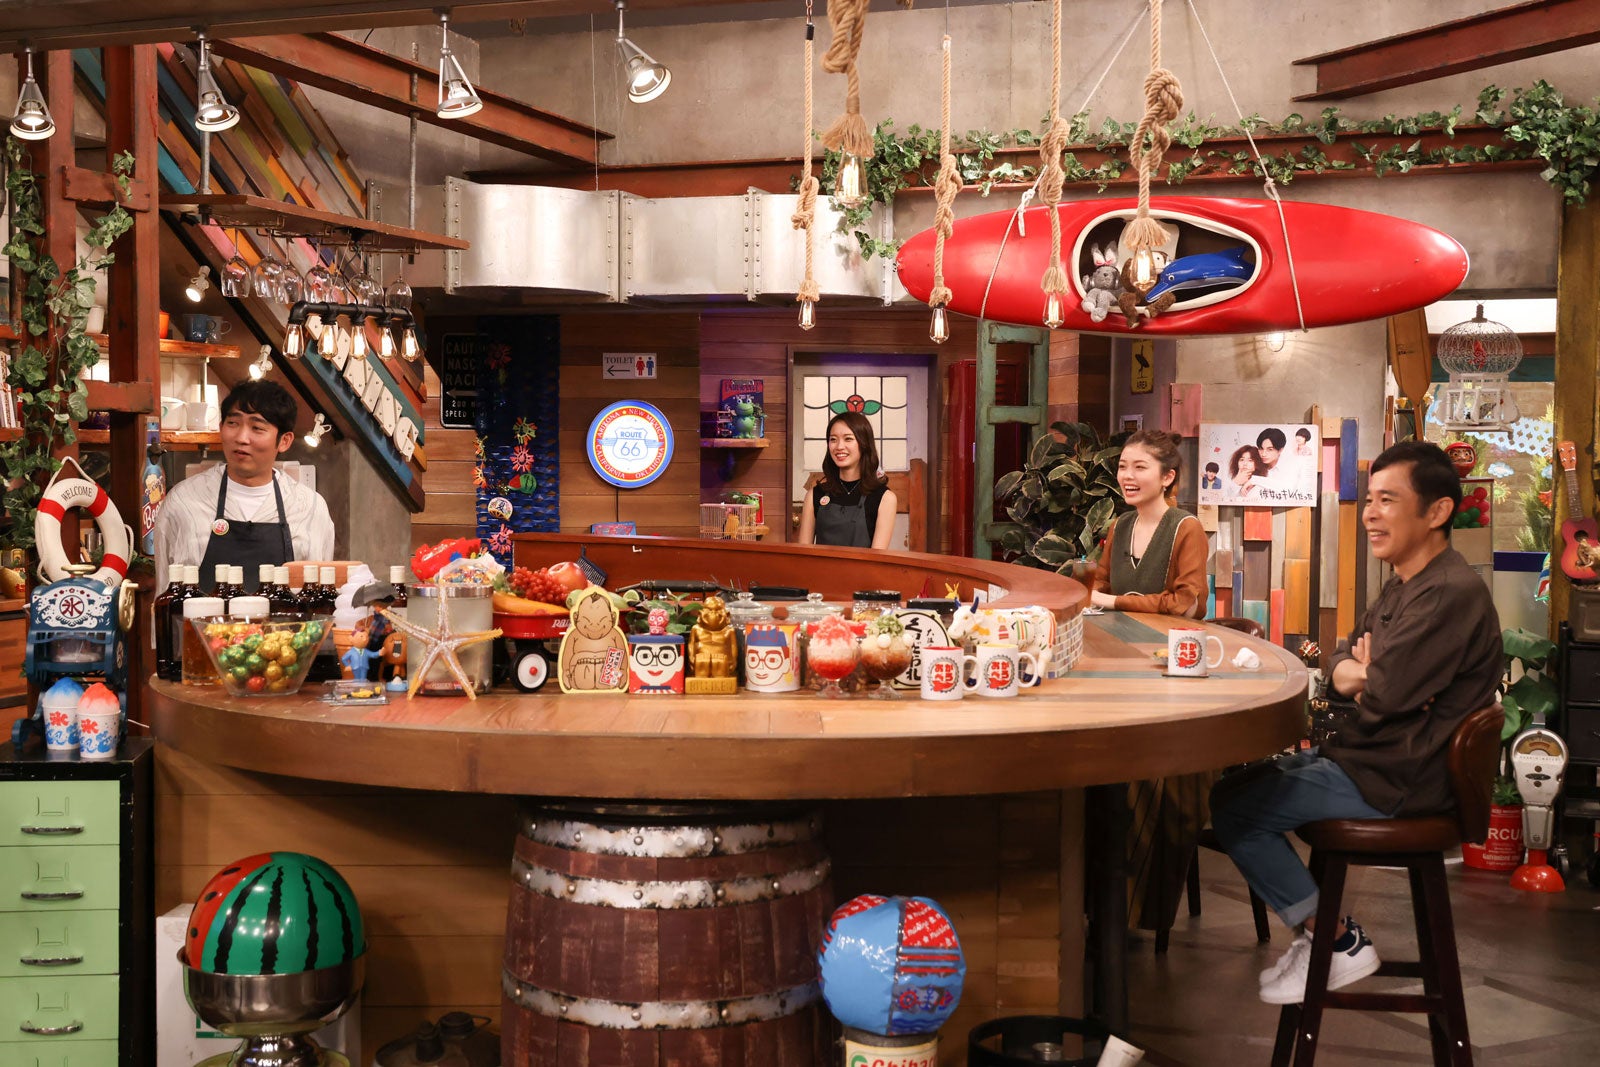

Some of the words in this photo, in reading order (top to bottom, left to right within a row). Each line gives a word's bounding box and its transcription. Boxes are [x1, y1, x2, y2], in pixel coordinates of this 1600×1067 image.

[604, 356, 634, 364] TOILET
[628, 408, 645, 416] NEW
[597, 412, 620, 438] ARIZONA
[645, 414, 664, 440] MEXICO
[620, 441, 641, 457] 66
[595, 444, 626, 479] CALIFORNIA
[634, 447, 665, 479] OKLAHOMA
[61, 486, 92, 501] WELCOME
[61, 597, 84, 617] 氷
[1487, 827, 1520, 841] RCU
